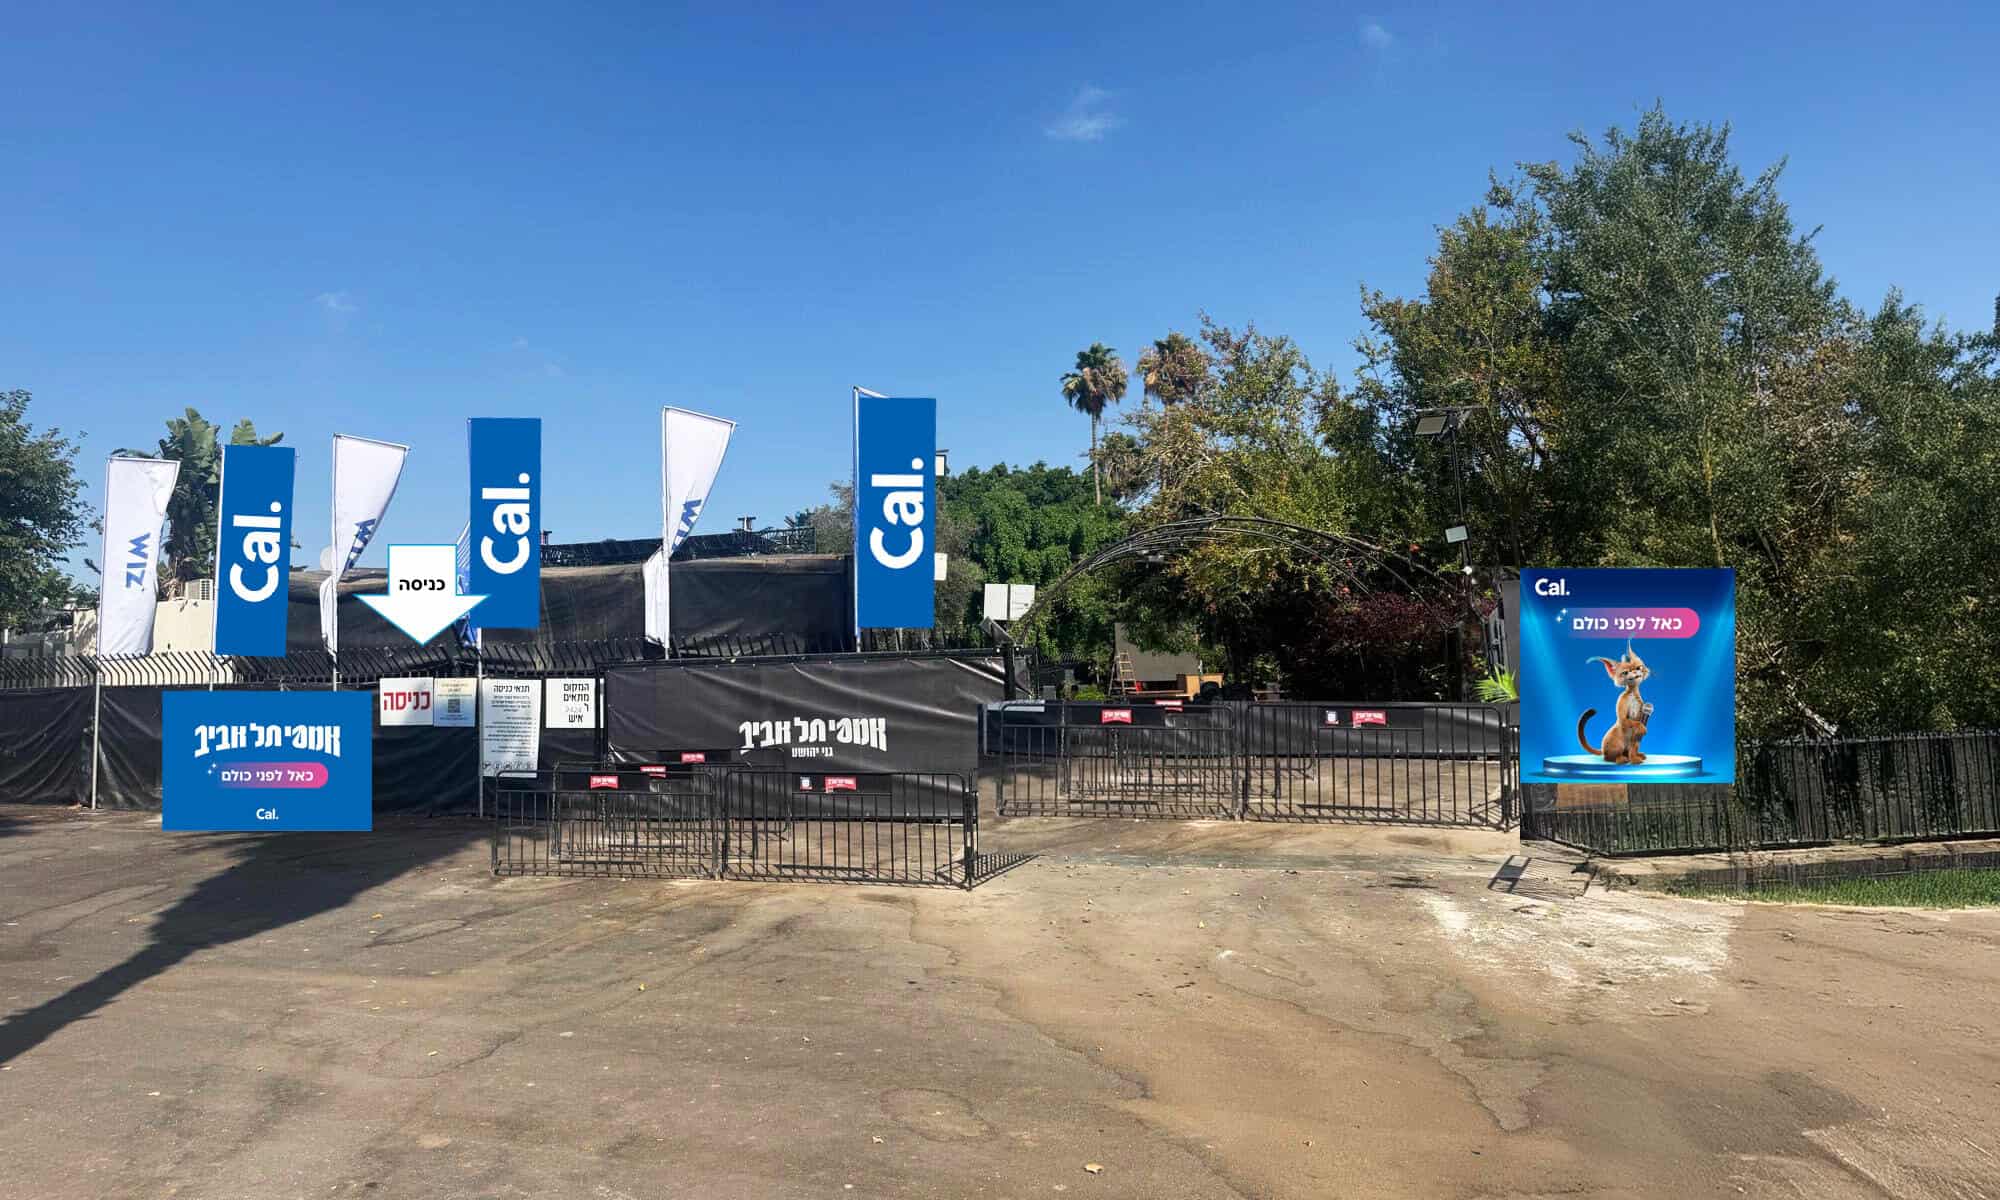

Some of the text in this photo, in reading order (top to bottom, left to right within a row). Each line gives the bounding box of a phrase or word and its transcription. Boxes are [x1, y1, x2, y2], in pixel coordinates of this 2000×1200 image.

[869, 457, 925, 570] Cal.
[480, 472, 531, 575] Cal.
[125, 532, 151, 588] ZIM
[229, 501, 282, 603] Cal.
[399, 578, 446, 591] כניסה
[1534, 577, 1570, 596] Cal.
[1573, 616, 1683, 631] כאל לפני כולם
[493, 685, 513, 694] כניסה
[563, 683, 590, 693] המקום
[563, 693, 590, 702] מתאים
[384, 691, 431, 711] כניסה
[568, 714, 584, 723] איש
[249, 722, 282, 748] תל
[793, 716, 827, 744] תל
[828, 716, 888, 752] אמפי
[284, 724, 341, 758] אמפי
[221, 769, 315, 782] כאל לפני כולם
[255, 808, 279, 820] Cal.
